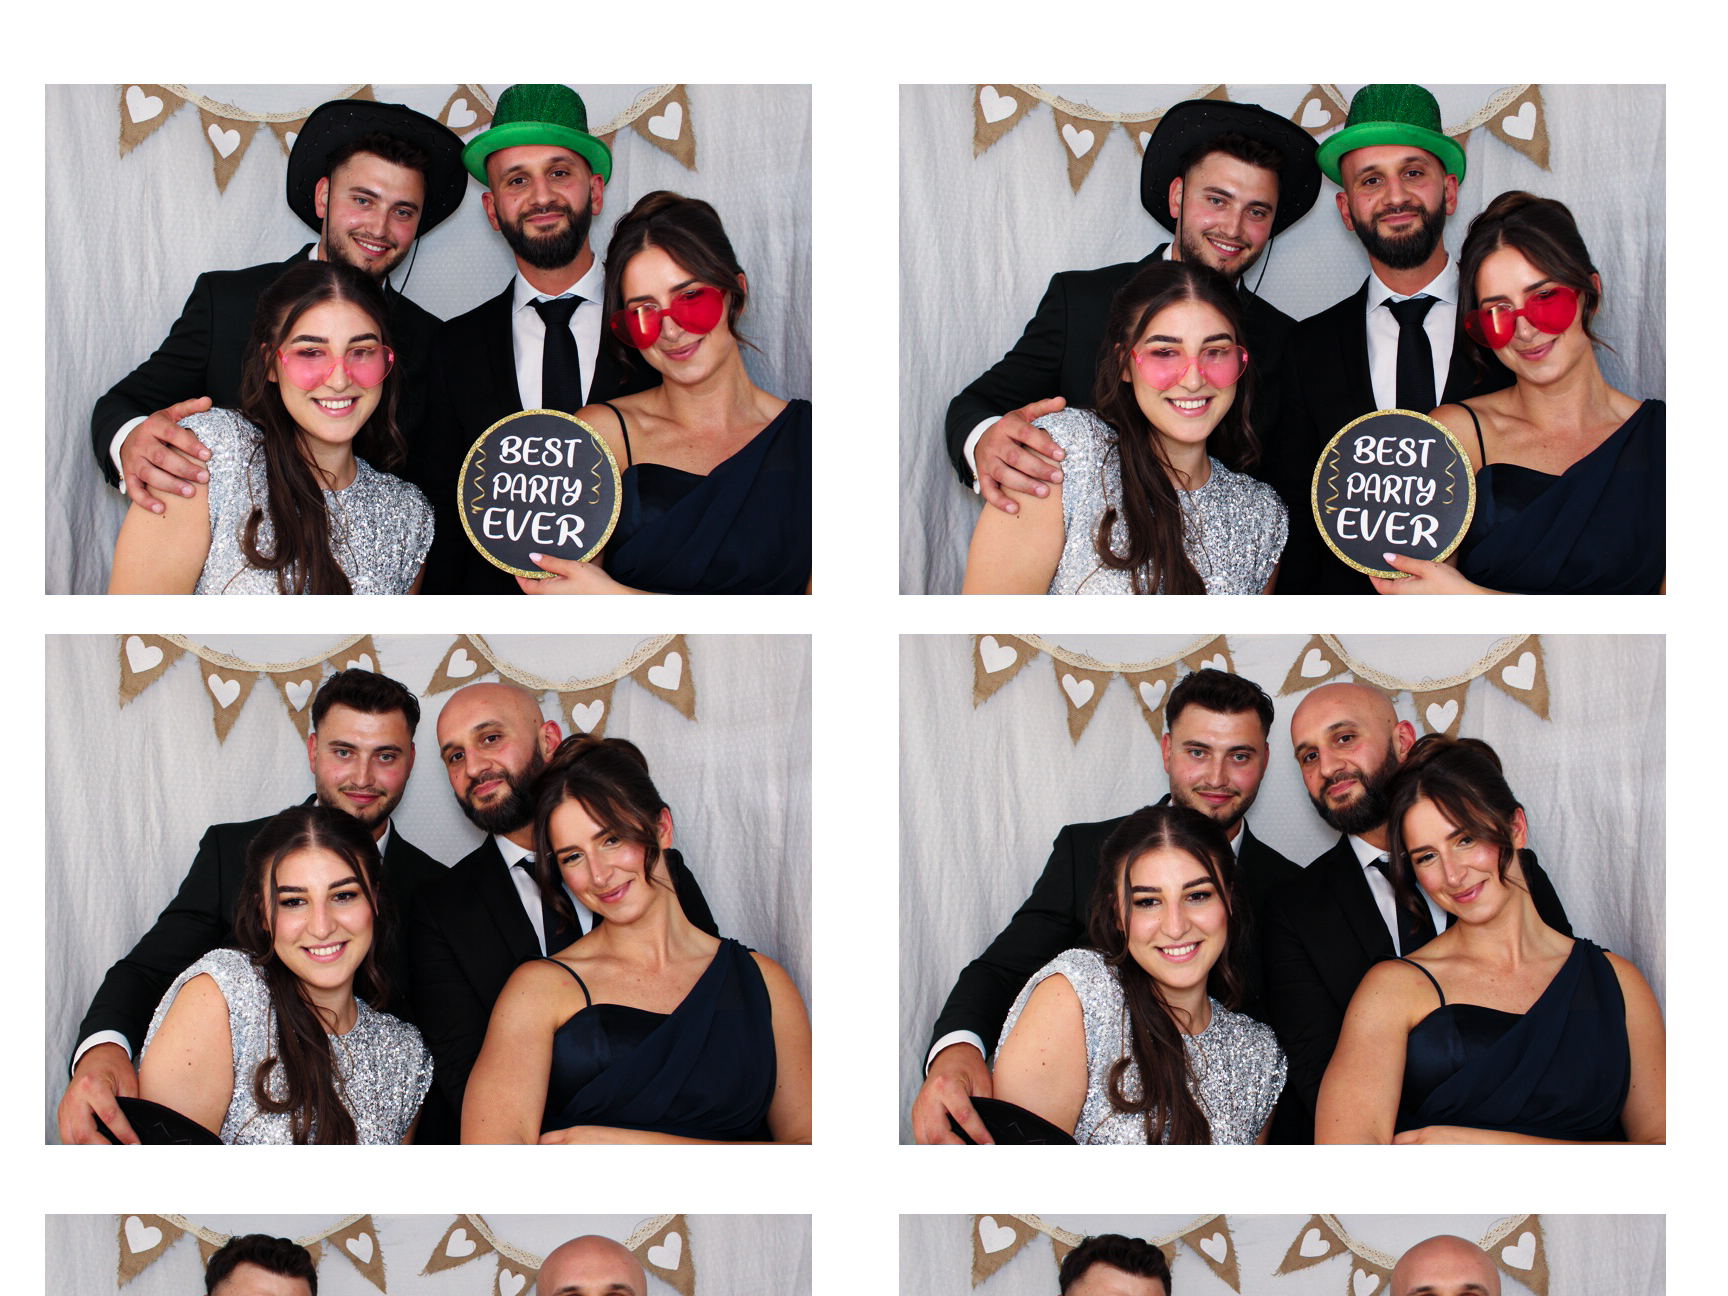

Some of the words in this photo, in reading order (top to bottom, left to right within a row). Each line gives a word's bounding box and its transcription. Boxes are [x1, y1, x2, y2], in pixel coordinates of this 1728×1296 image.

[499, 435, 582, 468] BEST
[1353, 435, 1436, 468] BEST
[492, 472, 583, 507] PARTY
[1346, 472, 1437, 507] PARTY
[482, 507, 585, 549] EVER
[1336, 507, 1439, 549] EVER
